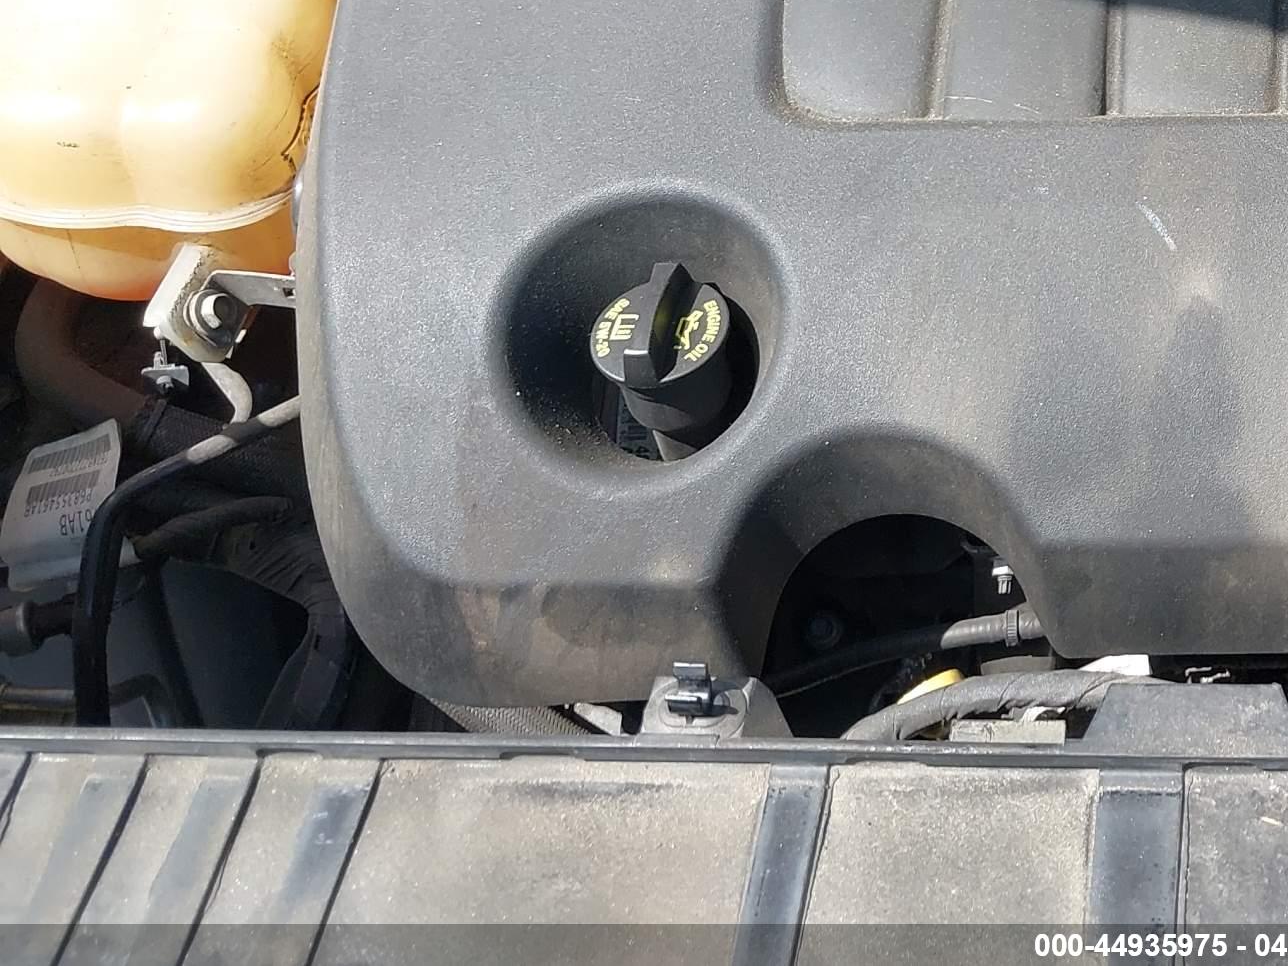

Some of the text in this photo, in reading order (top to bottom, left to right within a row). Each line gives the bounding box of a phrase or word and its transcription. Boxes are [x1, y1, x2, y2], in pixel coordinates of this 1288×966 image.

[595, 298, 630, 358] SAE 5W-20
[683, 299, 721, 362] ENGINE OIL
